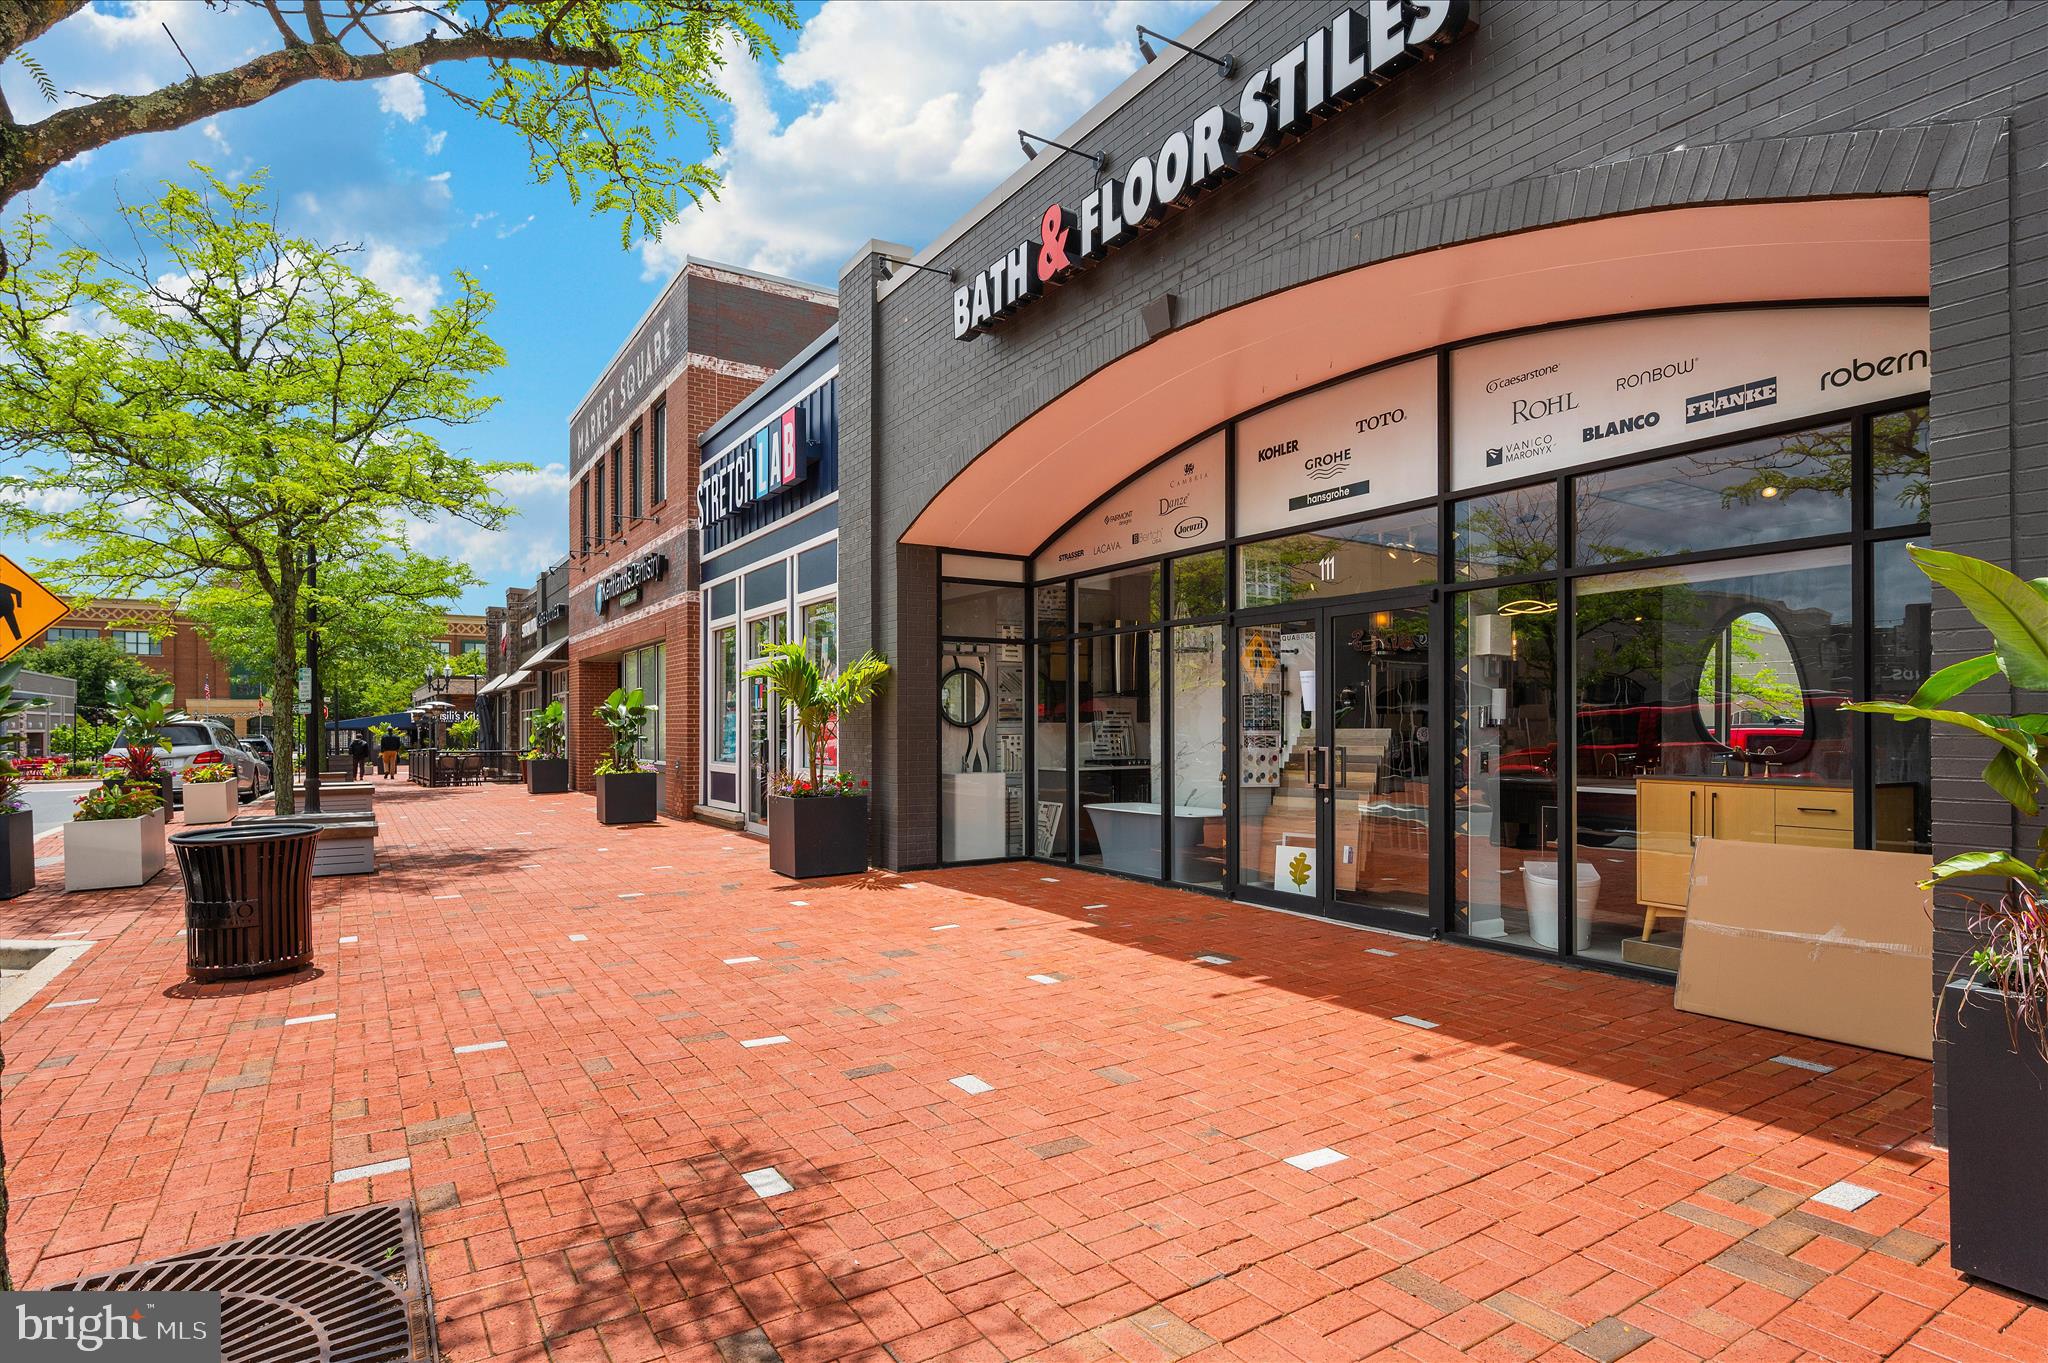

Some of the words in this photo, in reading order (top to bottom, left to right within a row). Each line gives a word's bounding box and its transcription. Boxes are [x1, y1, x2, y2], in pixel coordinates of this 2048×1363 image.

[953, 239, 1029, 340] BATH
[1037, 203, 1070, 282] &
[1081, 105, 1227, 258] FLOOR
[1499, 363, 1559, 388] caesarstone
[1616, 358, 1695, 392] RONBOW
[1820, 349, 1928, 391] robern
[577, 388, 615, 460] MARKET
[620, 318, 671, 410] SQUARE
[1686, 384, 1776, 418] FRANKE
[1355, 408, 1405, 434] TOTO
[1511, 392, 1580, 425] ROHL
[1582, 411, 1660, 443] BLANCO
[1258, 439, 1299, 462] KOHLER
[1505, 444, 1552, 463] MARONYX
[1506, 434, 1553, 453] VANICO
[1304, 448, 1352, 470] GROHE
[1307, 487, 1350, 505] hansgrohe
[1178, 519, 1204, 535] Jacuzzi
[1058, 549, 1085, 562] STRASSER
[1093, 541, 1121, 556] LACAVA
[1318, 556, 1335, 581] 111
